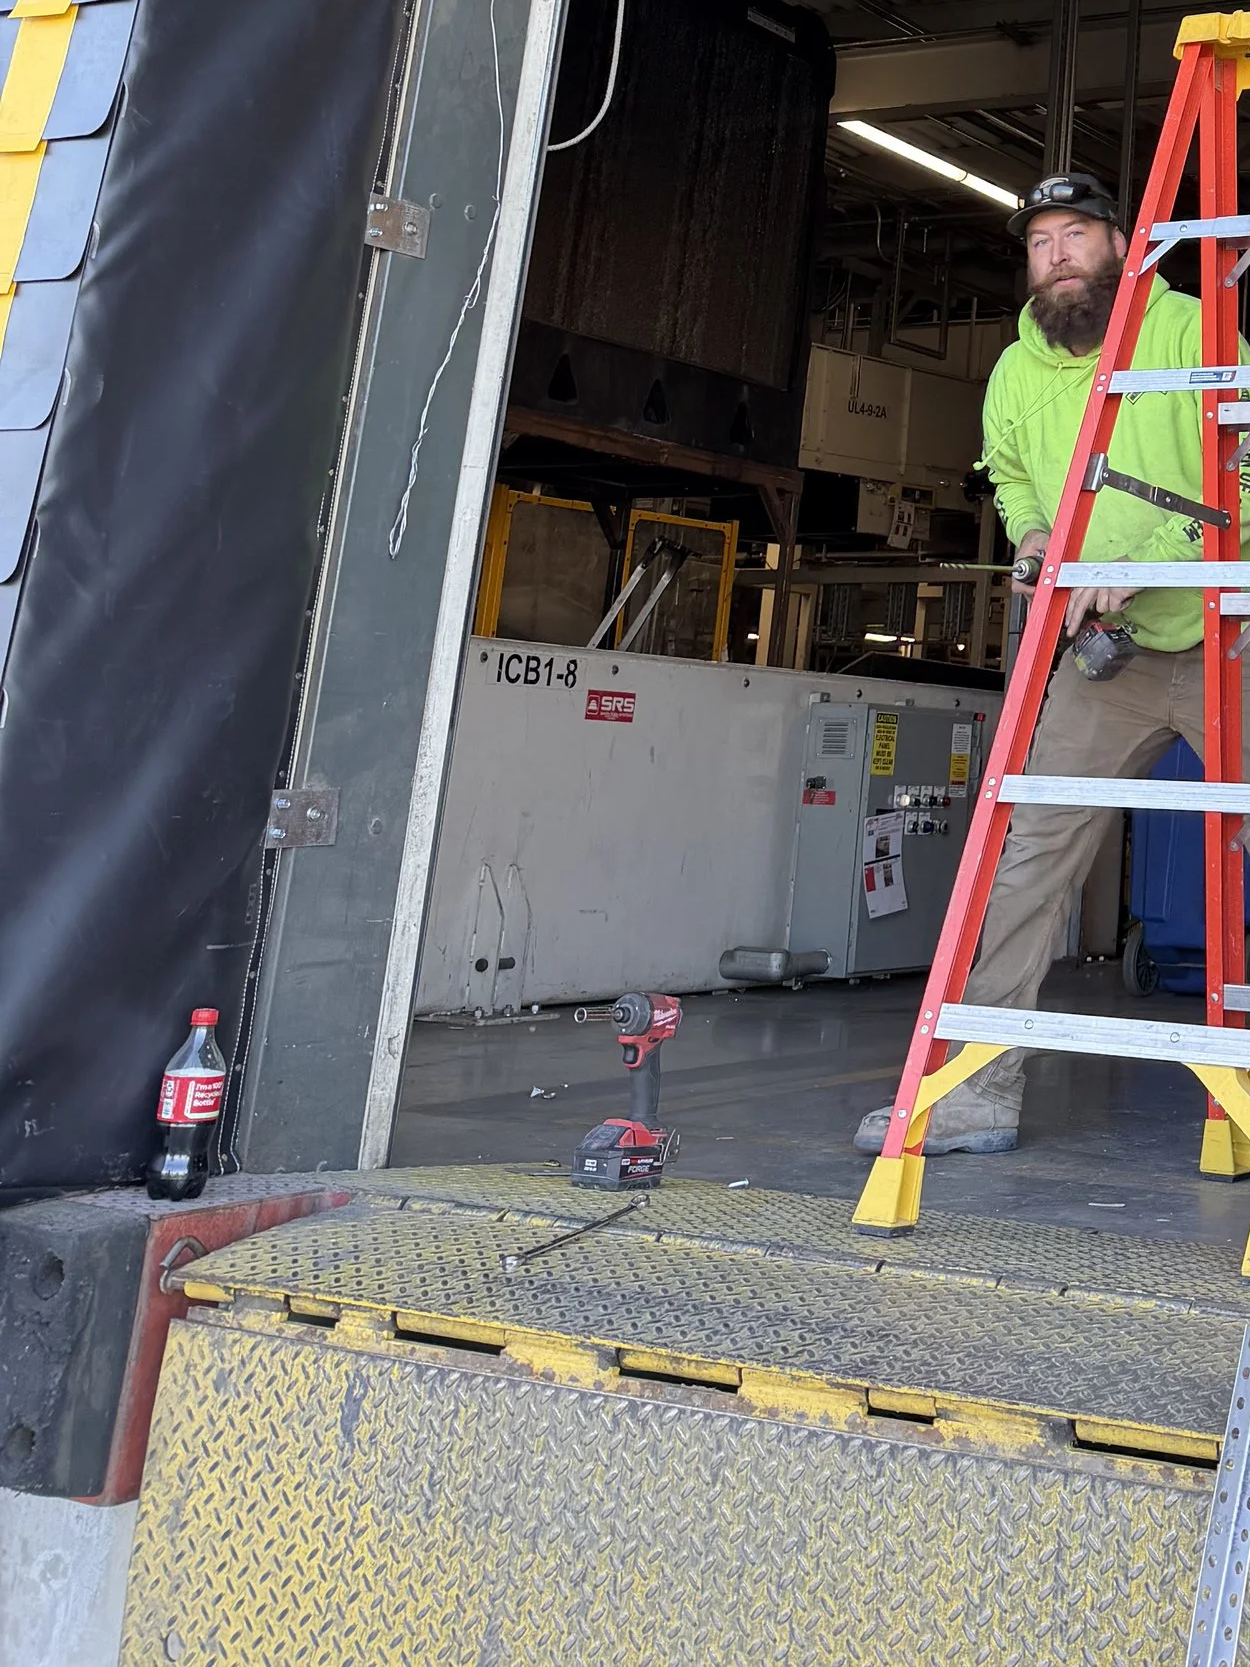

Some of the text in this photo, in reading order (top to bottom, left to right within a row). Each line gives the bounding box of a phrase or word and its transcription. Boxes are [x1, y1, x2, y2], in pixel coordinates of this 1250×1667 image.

[848, 400, 887, 419] UL4-9-2A
[496, 653, 578, 688] ICB1-8
[601, 696, 635, 713] SRS
